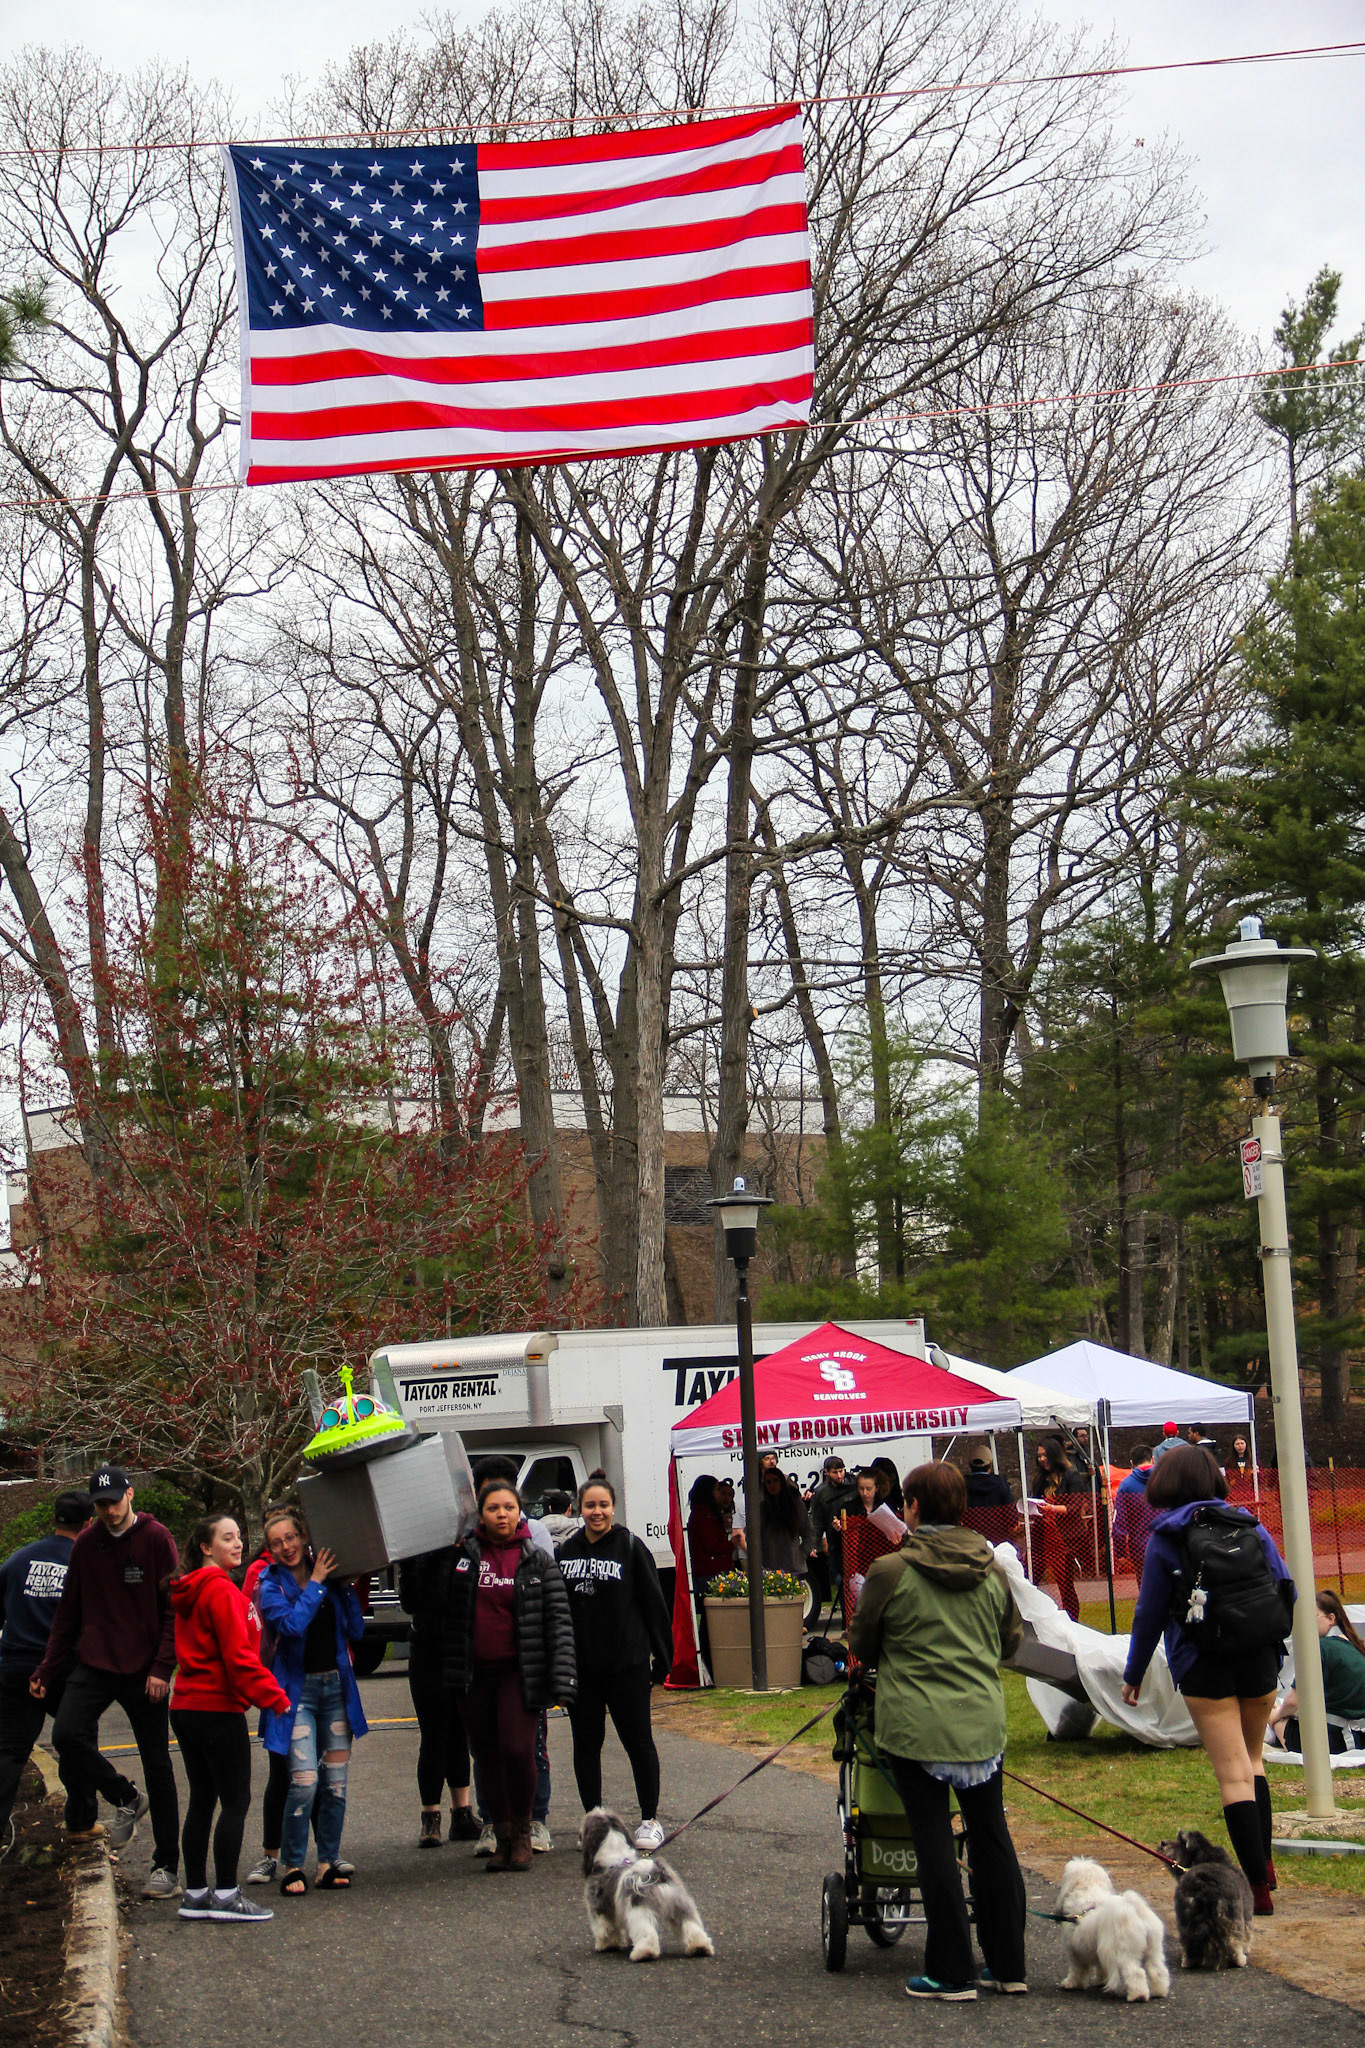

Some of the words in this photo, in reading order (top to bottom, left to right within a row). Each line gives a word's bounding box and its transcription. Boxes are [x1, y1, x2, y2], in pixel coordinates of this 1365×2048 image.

[800, 1352, 829, 1362] STONY
[833, 1351, 867, 1362] BROOK
[819, 1360, 856, 1391] SB
[400, 1378, 448, 1402] TAYLOR
[452, 1380, 496, 1398] RENTAL
[813, 1392, 867, 1401] SEAWOLVES
[419, 1405, 435, 1413] PORT
[437, 1403, 473, 1412] JEFFERSON,
[474, 1402, 482, 1410] NY
[722, 1422, 780, 1449] STNY
[789, 1416, 854, 1441] BROOK
[861, 1406, 969, 1435] UNIVERSITY
[730, 1452, 744, 1462] PO
[822, 1446, 835, 1455] NY
[98, 1473, 111, 1487] NY
[646, 1522, 669, 1539] EQU
[28, 1560, 69, 1578] TAYLOR
[458, 1561, 470, 1569] AP
[590, 1557, 622, 1580] BROOK
[25, 1574, 64, 1589] RENTAL
[483, 1575, 515, 1586] Sagan
